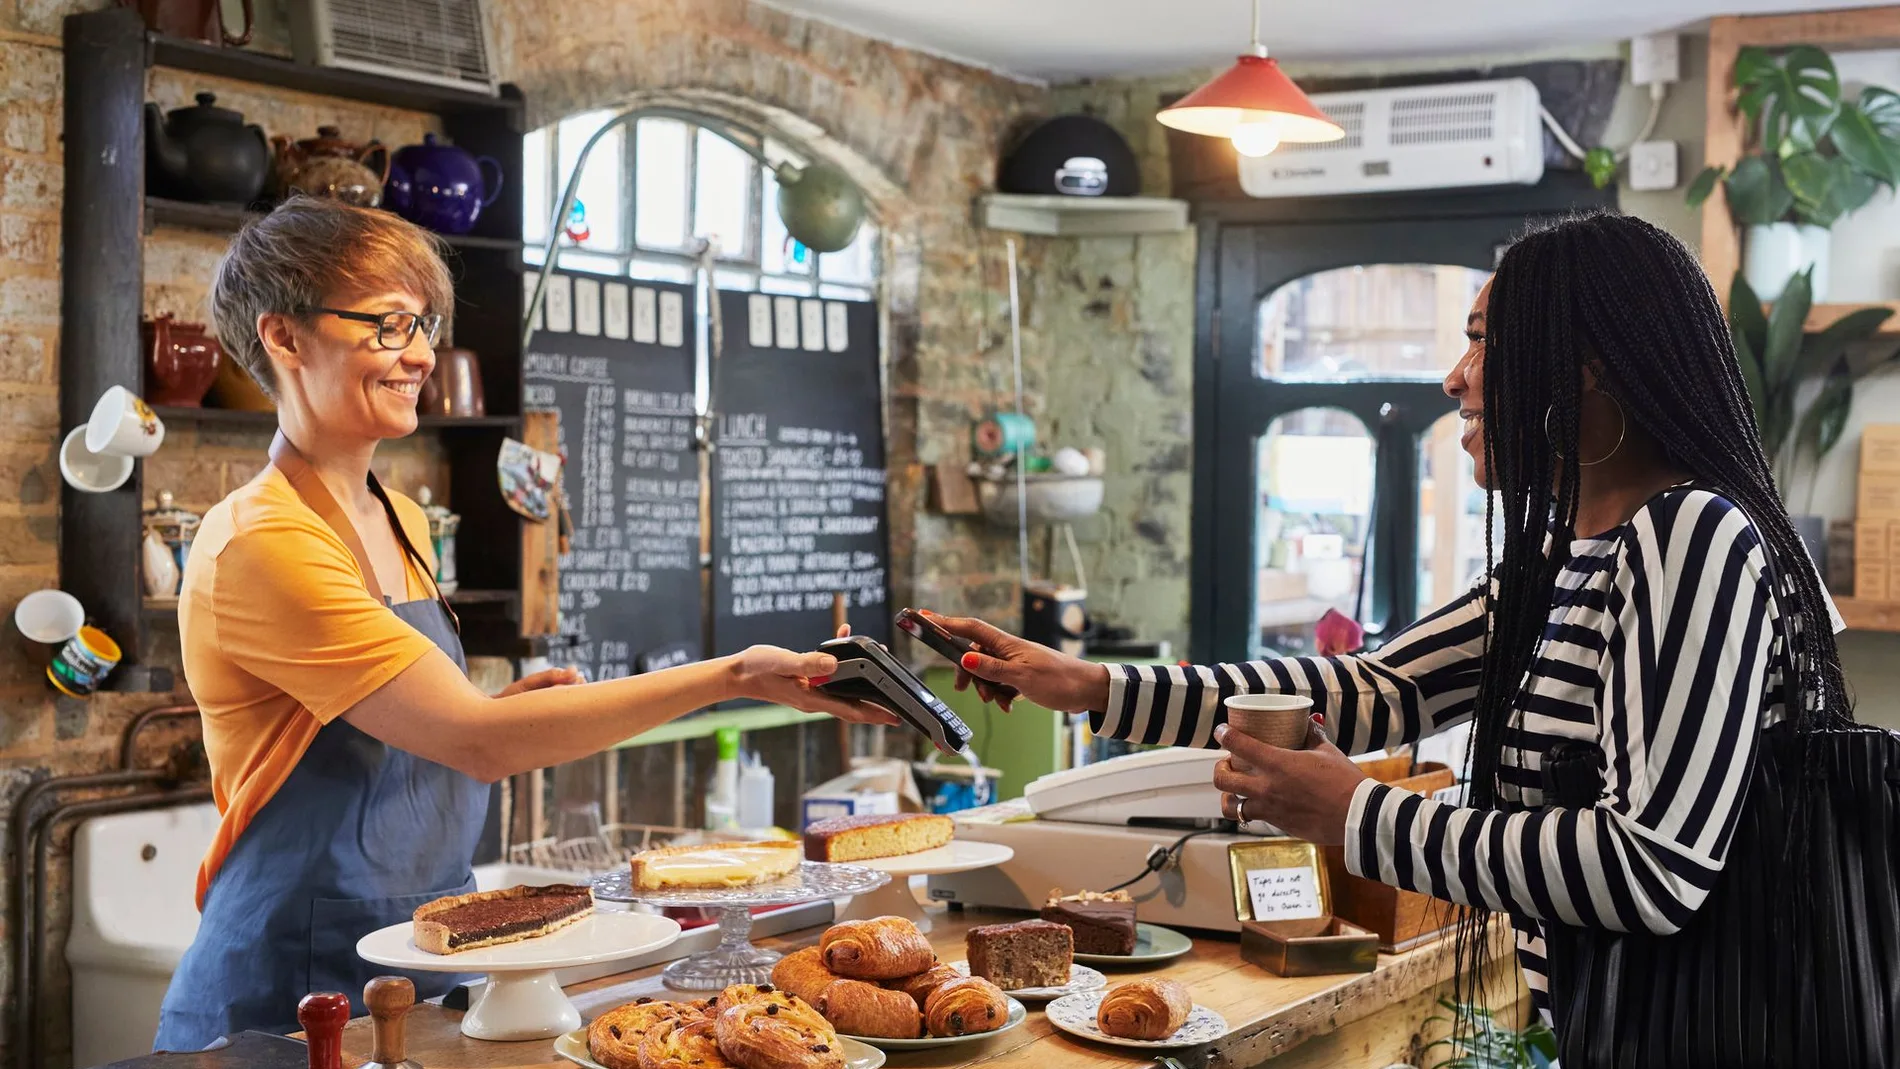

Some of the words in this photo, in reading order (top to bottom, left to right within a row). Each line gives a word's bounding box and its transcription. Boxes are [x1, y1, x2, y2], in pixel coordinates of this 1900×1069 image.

[718, 413, 767, 440] LUNCH
[1253, 875, 1272, 888] Tips
[1276, 874, 1285, 883] do
[1290, 874, 1302, 883] not
[1257, 891, 1265, 902] go
[1267, 904, 1275, 913] to
